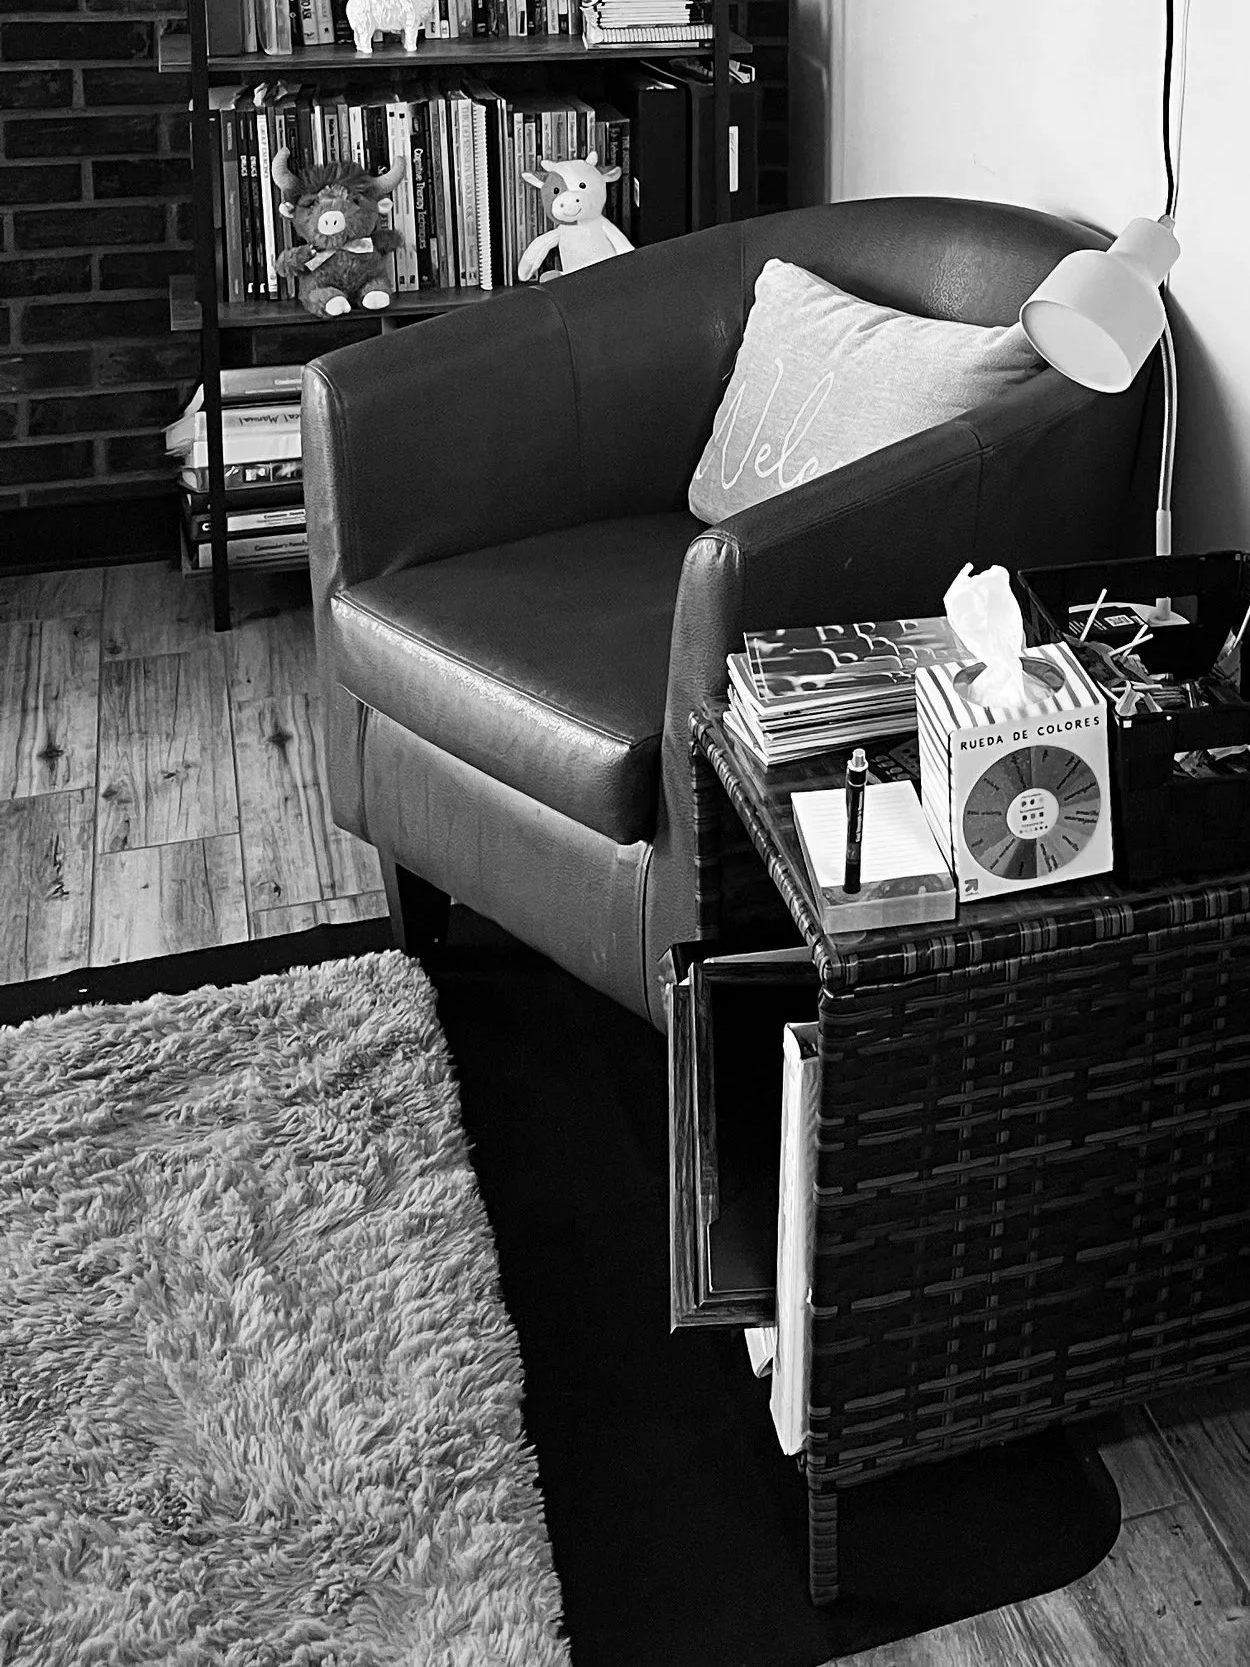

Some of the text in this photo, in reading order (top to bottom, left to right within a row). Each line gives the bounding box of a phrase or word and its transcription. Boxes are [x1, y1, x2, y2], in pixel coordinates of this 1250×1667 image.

[302, 8, 312, 20] ASK
[413, 148, 427, 249] Cognitive Therapy Techniques
[695, 358, 844, 490] Welc
[961, 716, 1099, 750] RUEDA DE COLORES
